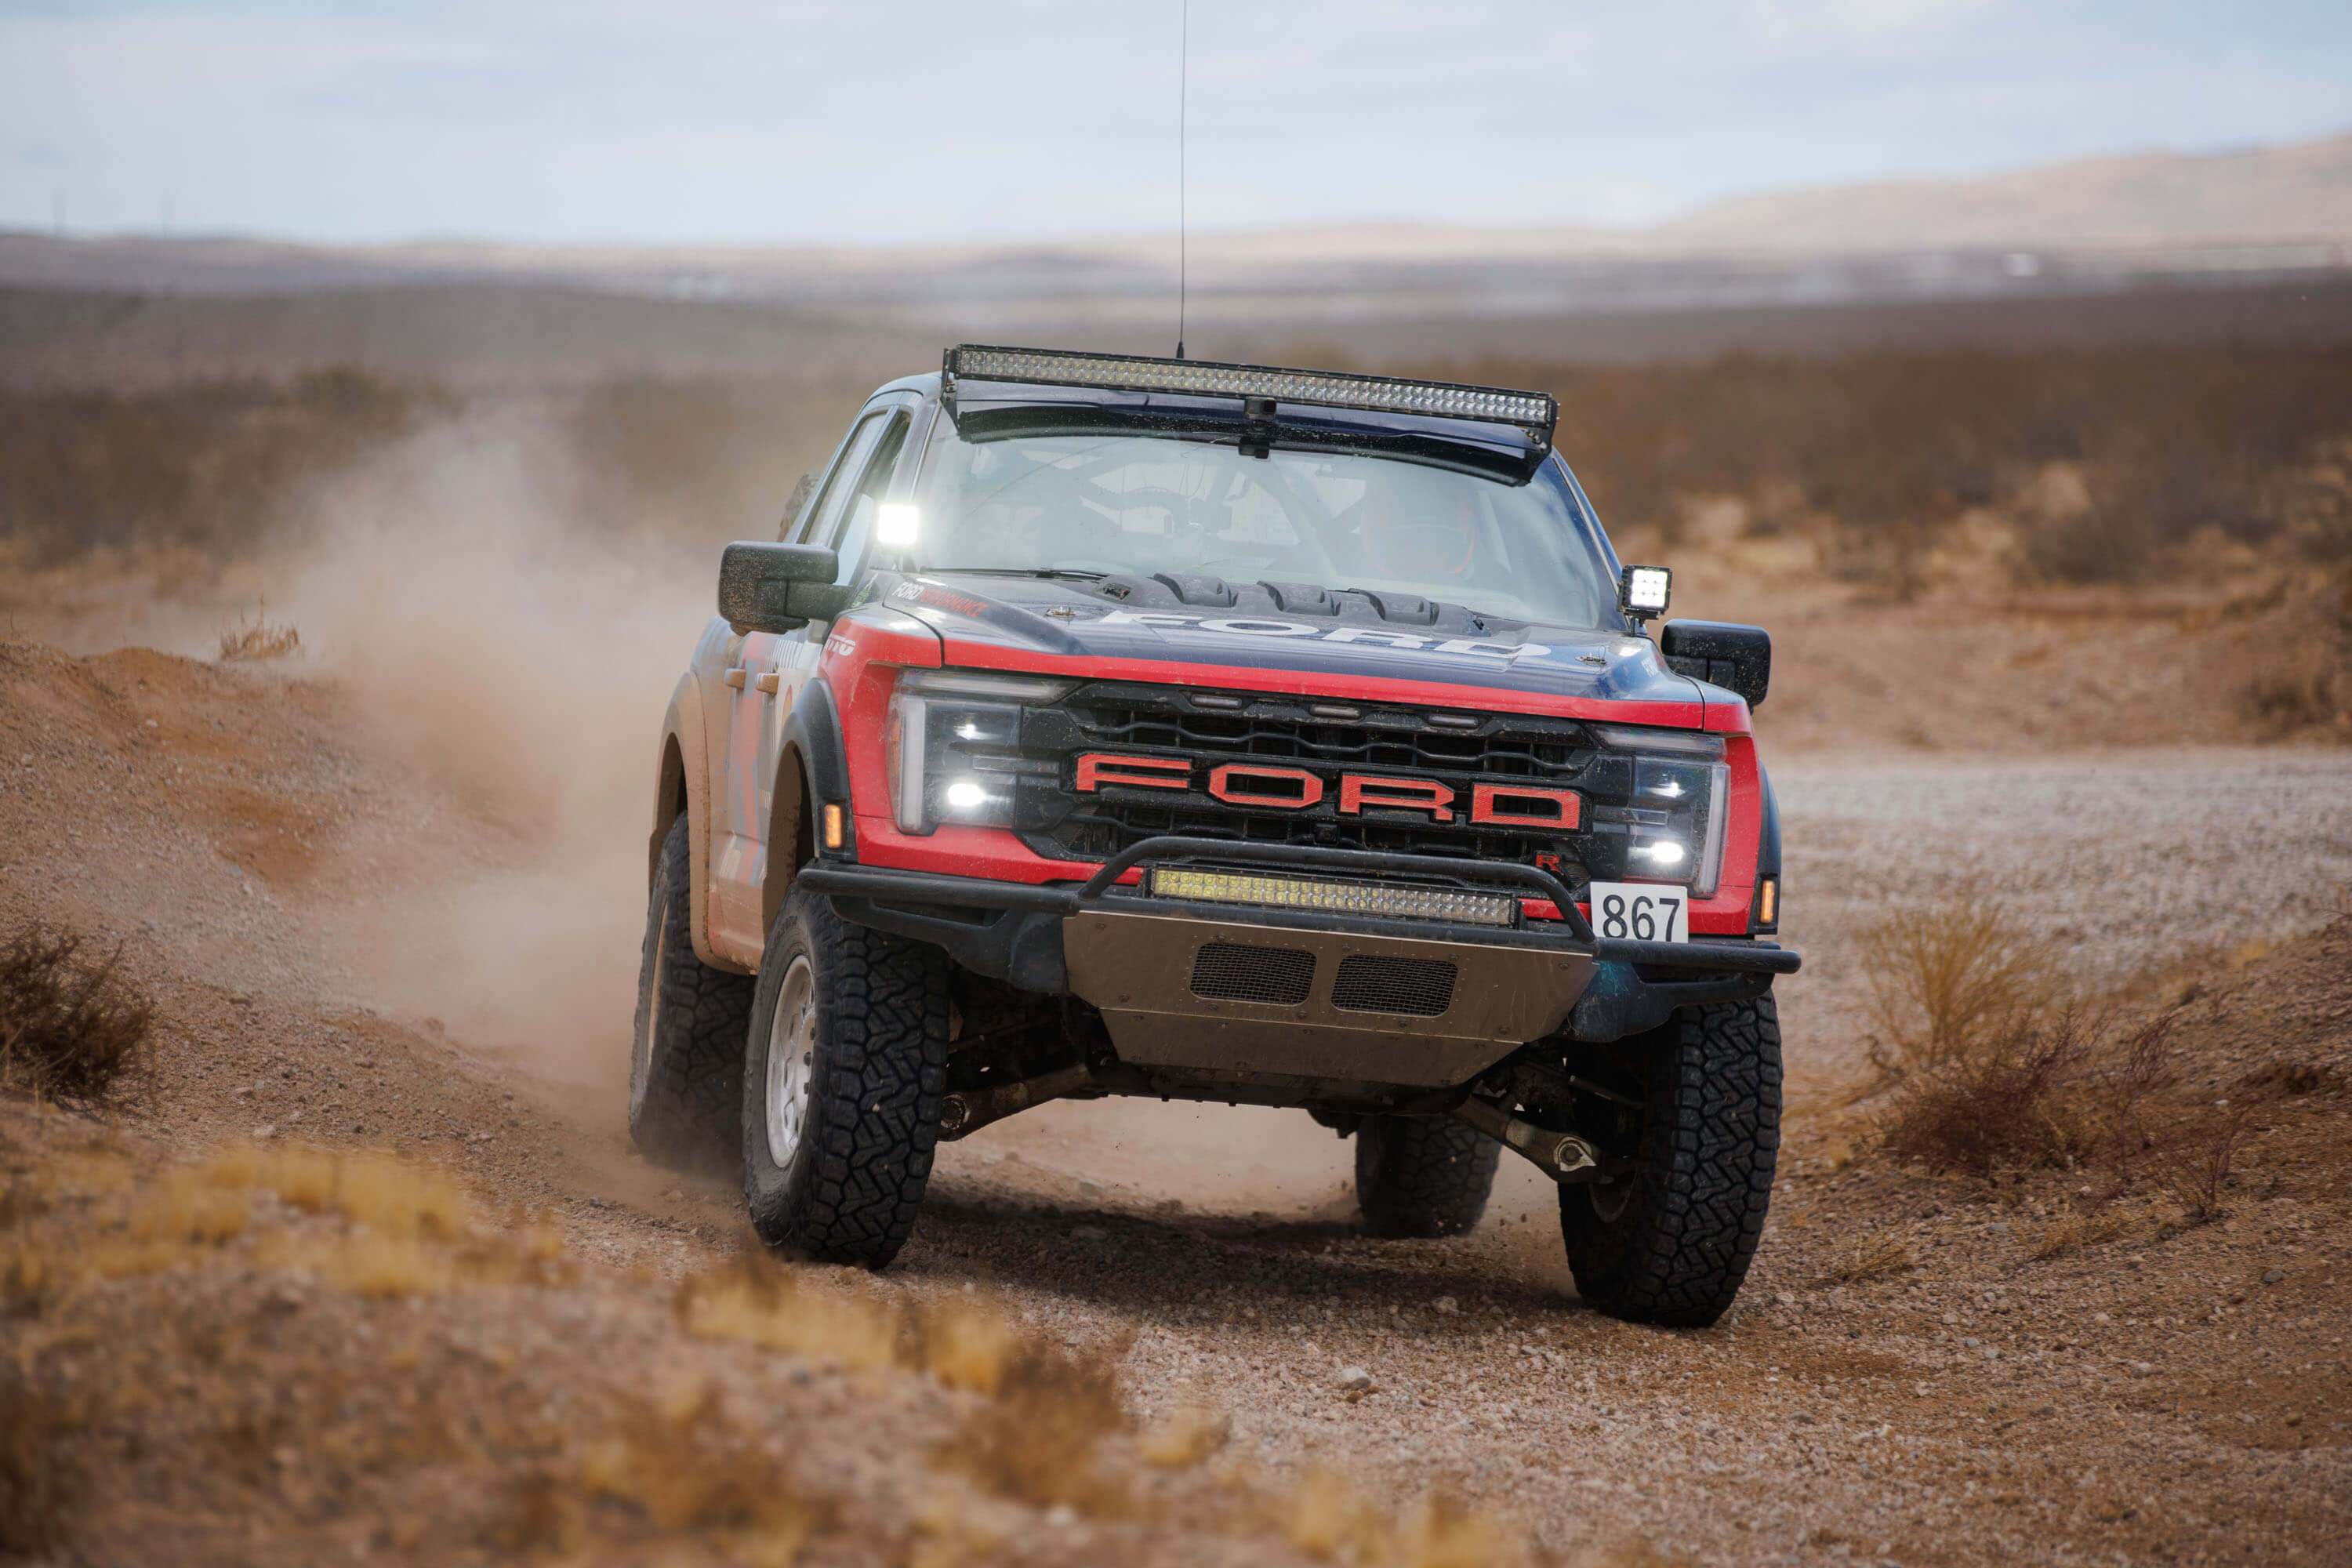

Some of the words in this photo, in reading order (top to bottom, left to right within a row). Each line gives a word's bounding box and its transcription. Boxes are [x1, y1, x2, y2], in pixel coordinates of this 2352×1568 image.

[891, 582, 925, 601] FORD
[916, 588, 989, 618] PERFORMANCE
[1099, 610, 1552, 658] FORD
[1076, 753, 1581, 829] FORD
[1602, 894, 1680, 942] 867
